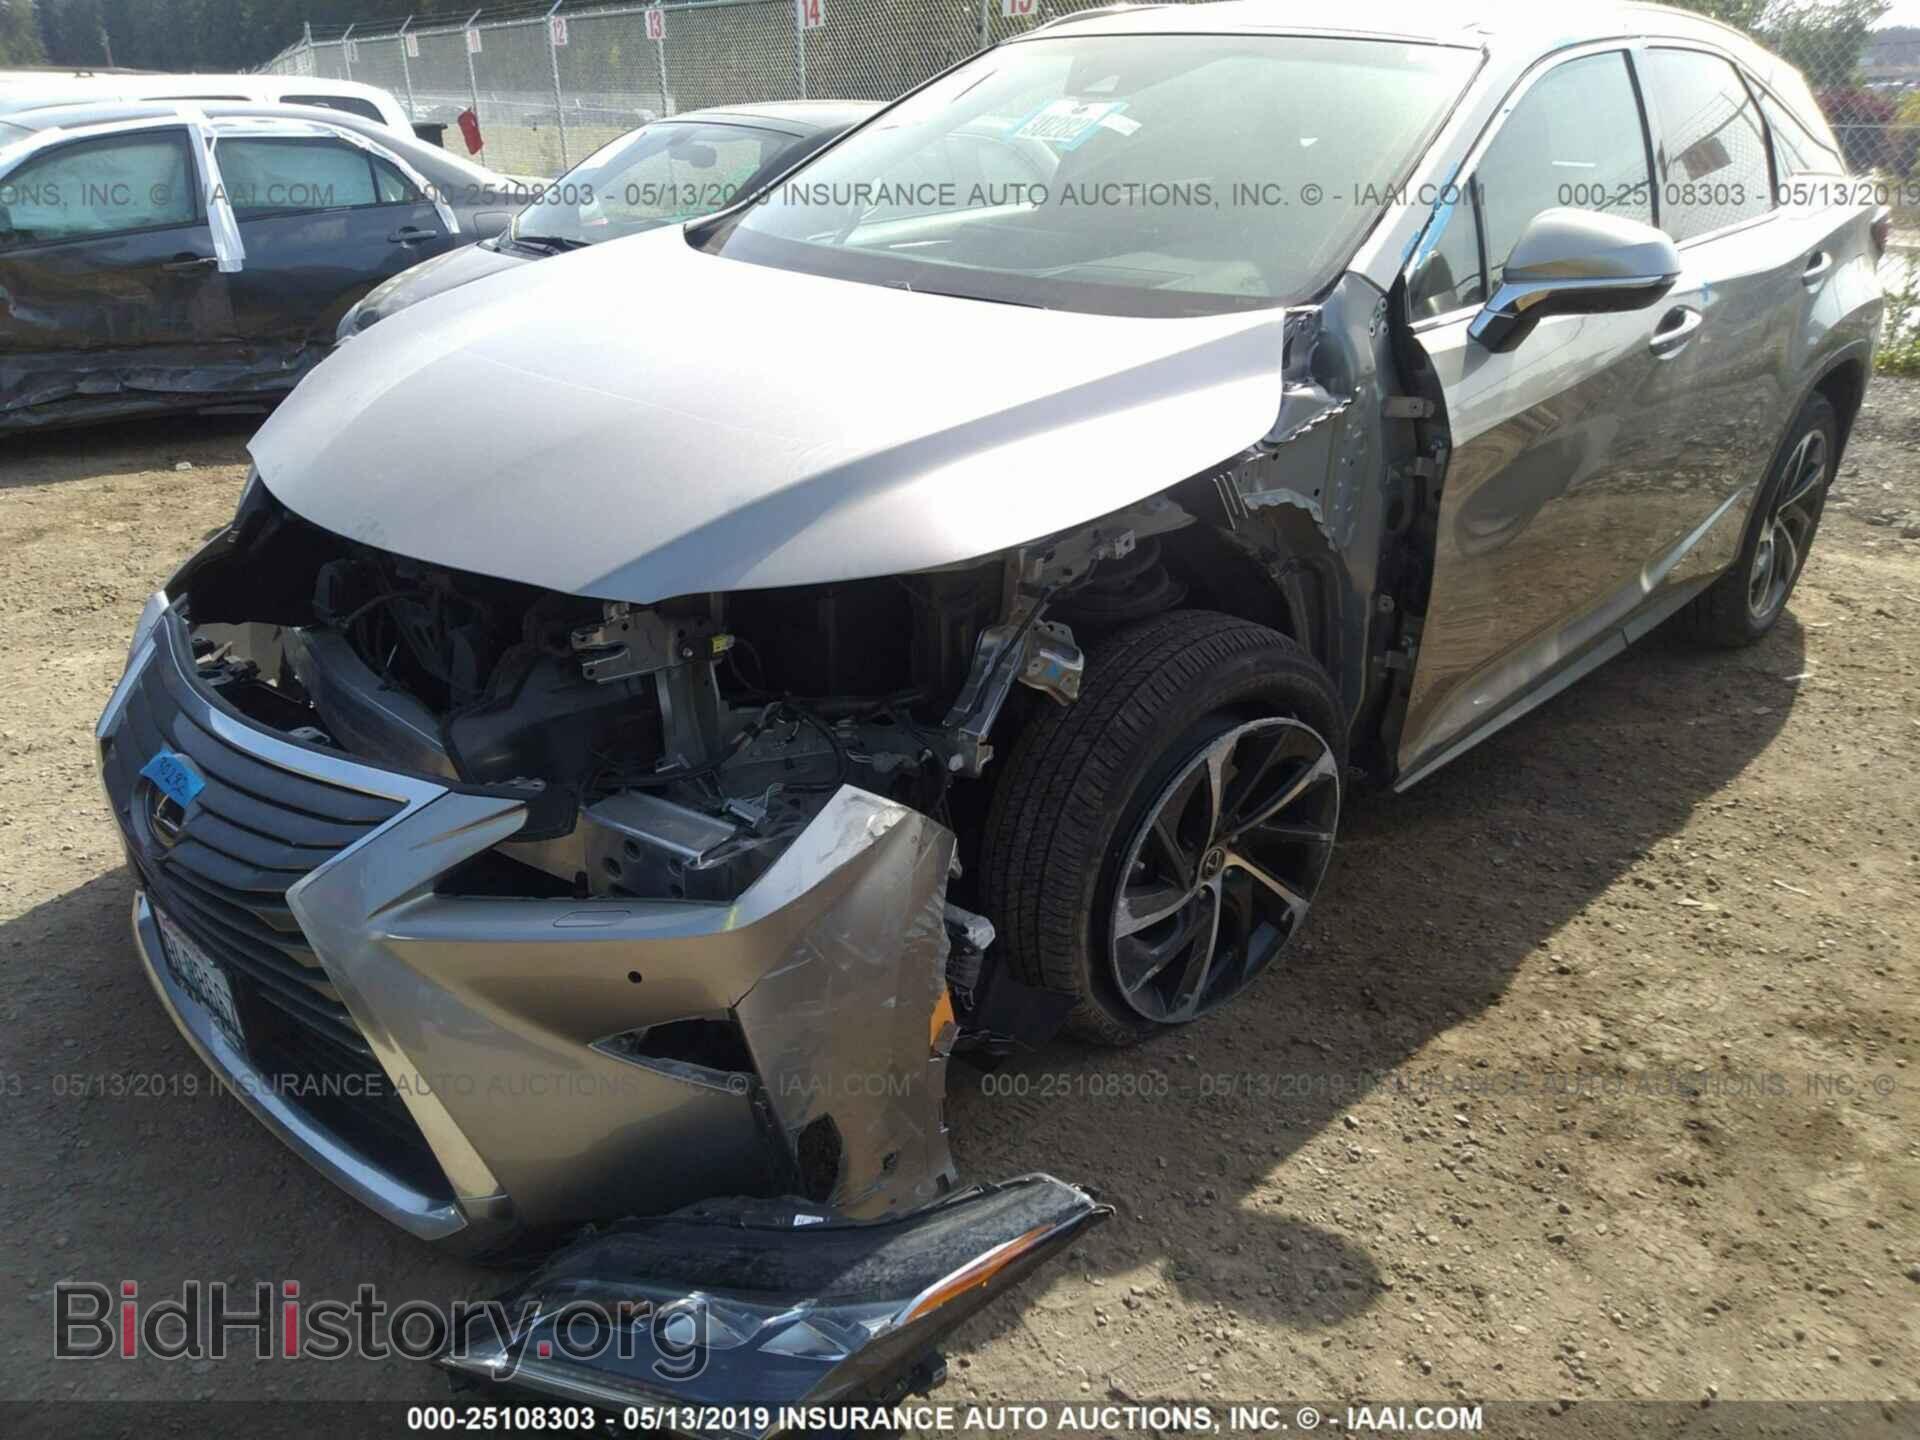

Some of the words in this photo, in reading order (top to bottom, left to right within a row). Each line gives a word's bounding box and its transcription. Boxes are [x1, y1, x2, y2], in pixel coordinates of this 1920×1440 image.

[650, 11, 662, 37] 13
[803, 0, 821, 26] 14
[553, 18, 564, 43] 12
